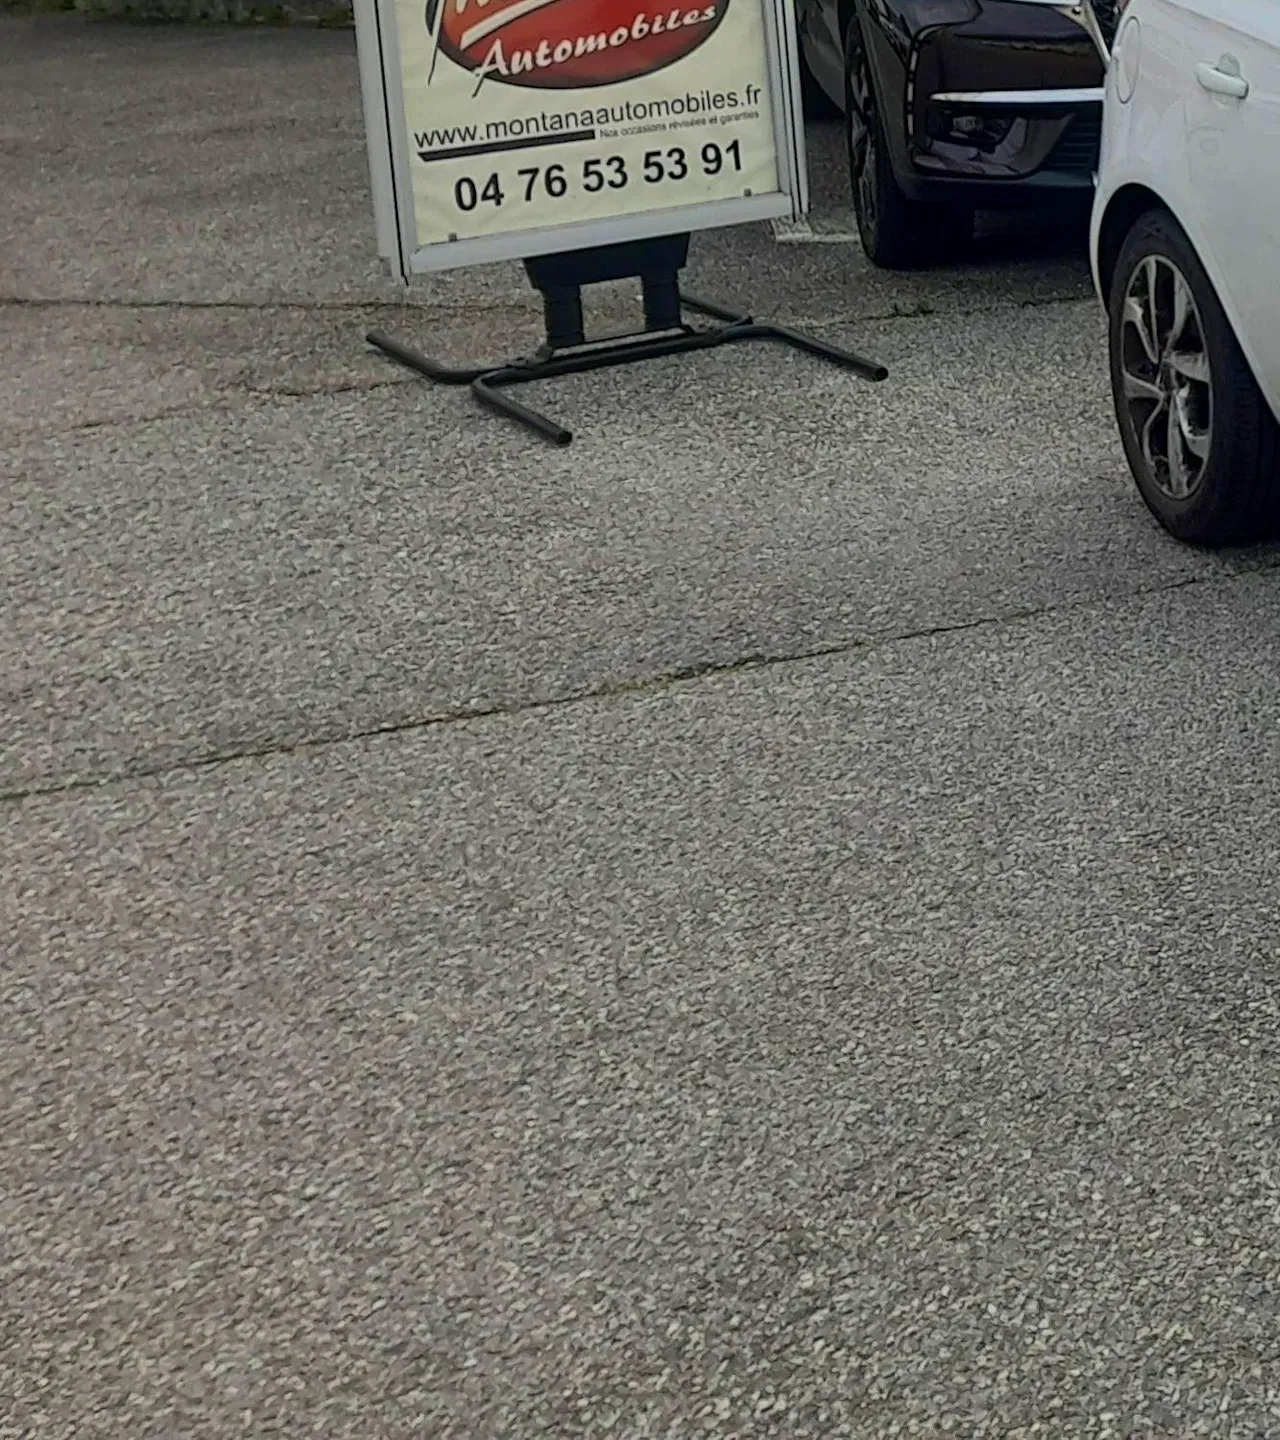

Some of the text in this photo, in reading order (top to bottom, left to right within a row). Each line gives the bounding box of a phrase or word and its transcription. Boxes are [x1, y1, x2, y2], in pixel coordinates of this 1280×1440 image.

[472, 5, 716, 98] Automobiles
[415, 84, 762, 149] www.montanaautomobiles.fr
[454, 139, 743, 211] 04 76 53 53 91
